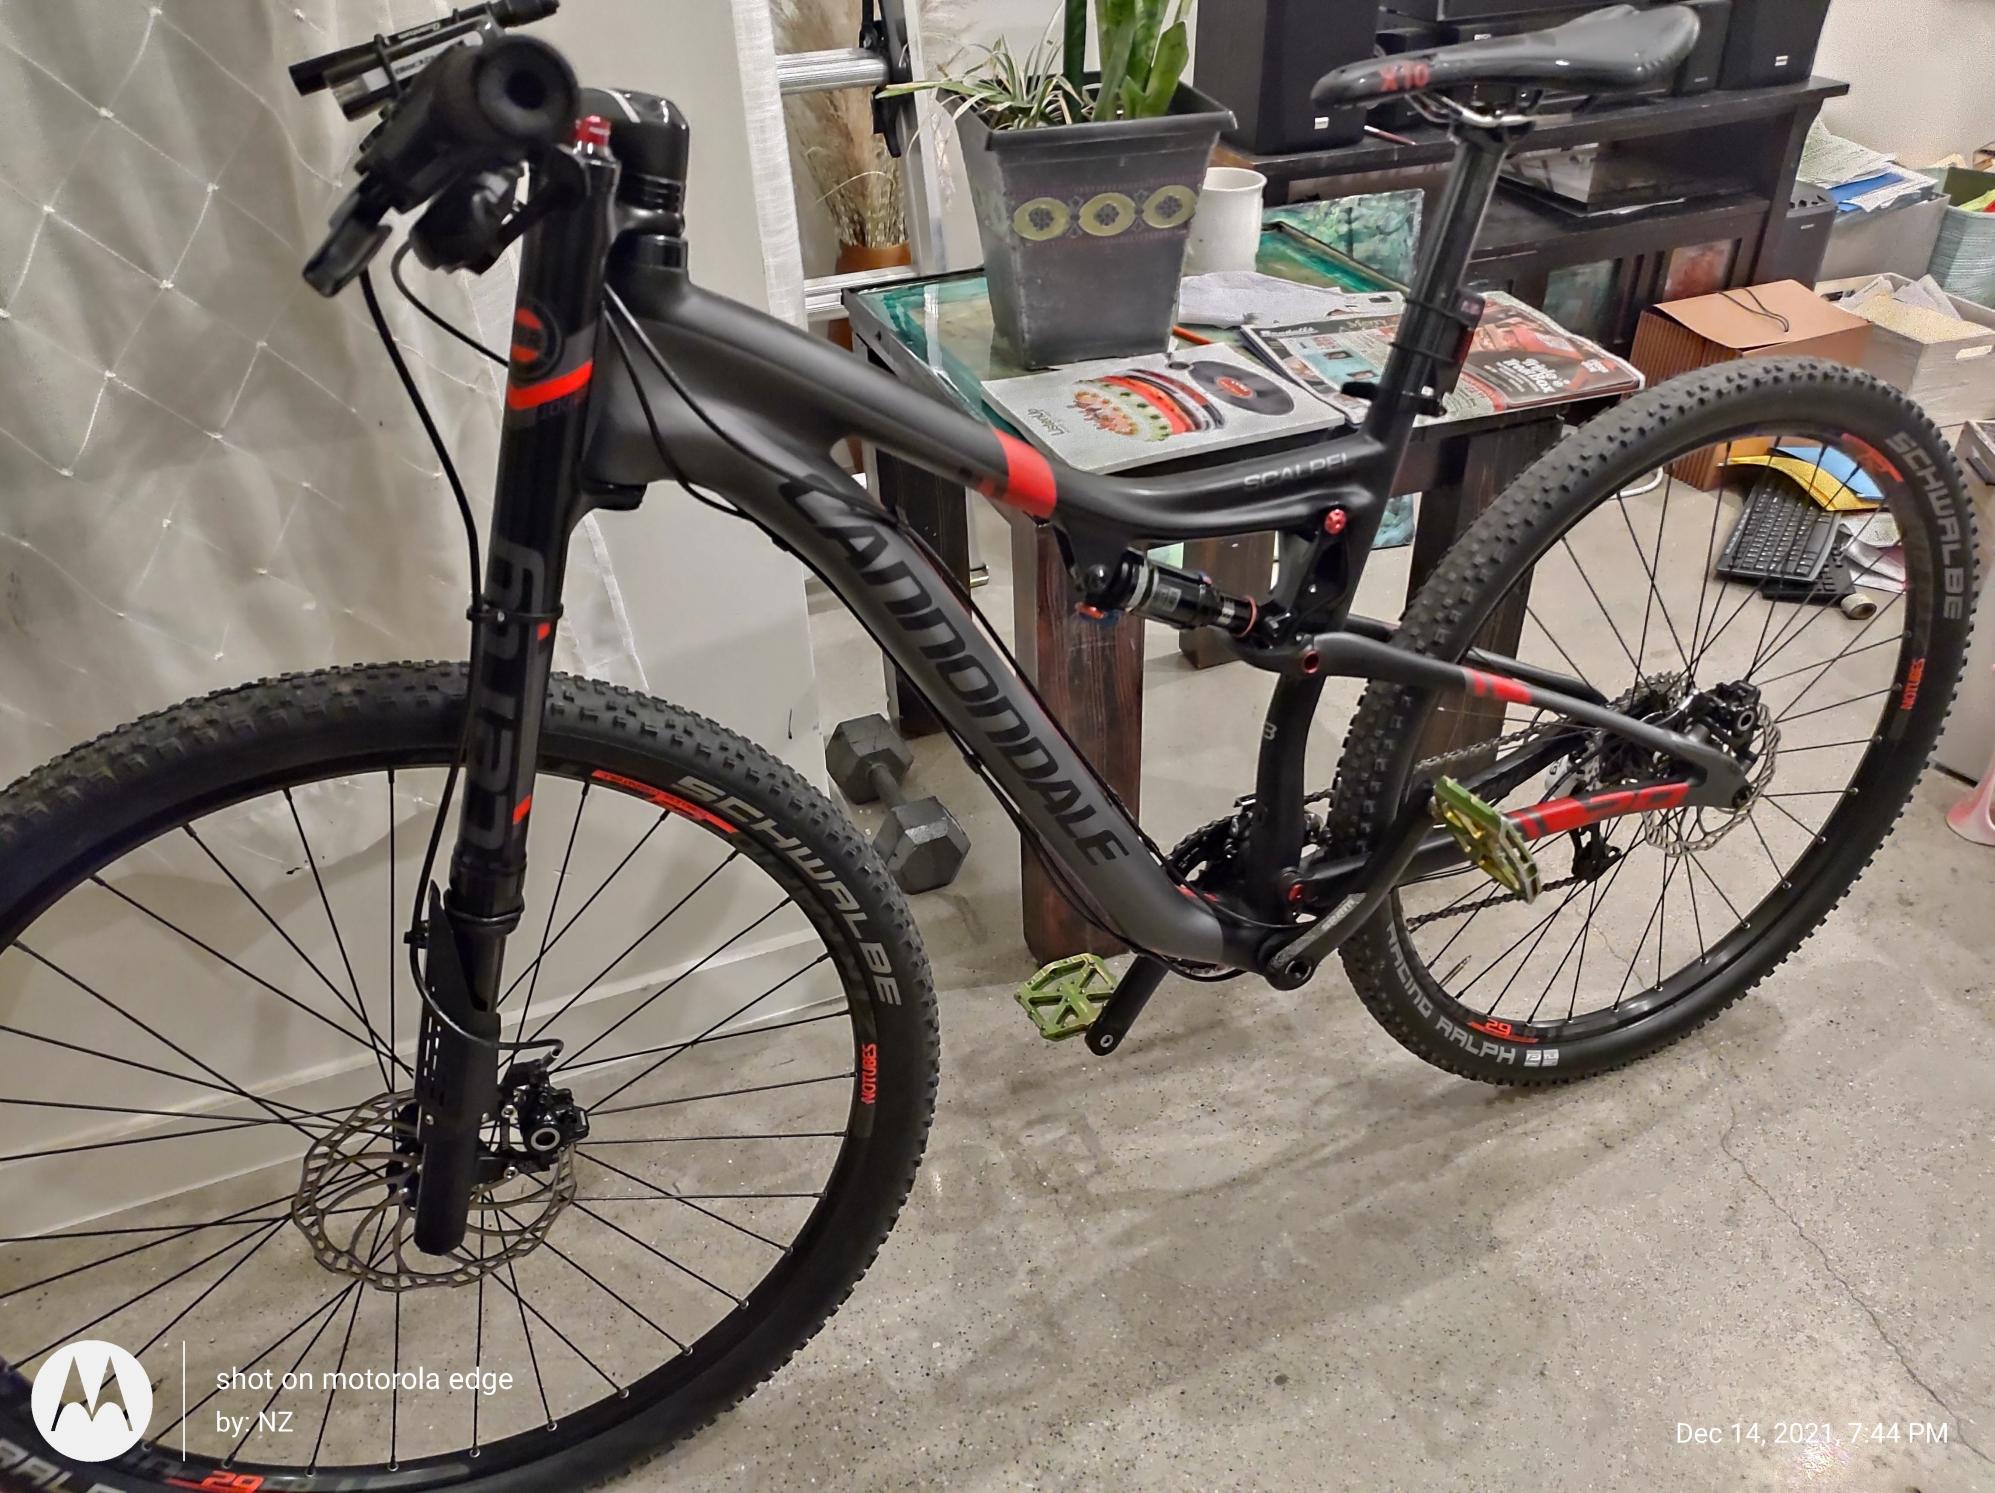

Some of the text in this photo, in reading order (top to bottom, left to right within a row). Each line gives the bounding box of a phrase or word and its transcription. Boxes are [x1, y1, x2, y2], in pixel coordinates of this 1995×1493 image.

[1885, 430, 1965, 620] SCHWALBE
[777, 473, 1130, 866] CANNONDALE
[1901, 657, 1927, 710] NOTUBES
[671, 775, 902, 1006] SCHWALBE
[1386, 921, 1516, 1065] RACING RALPH
[1485, 1018, 1512, 1036] 29
[860, 1043, 878, 1105] NOTUBES
